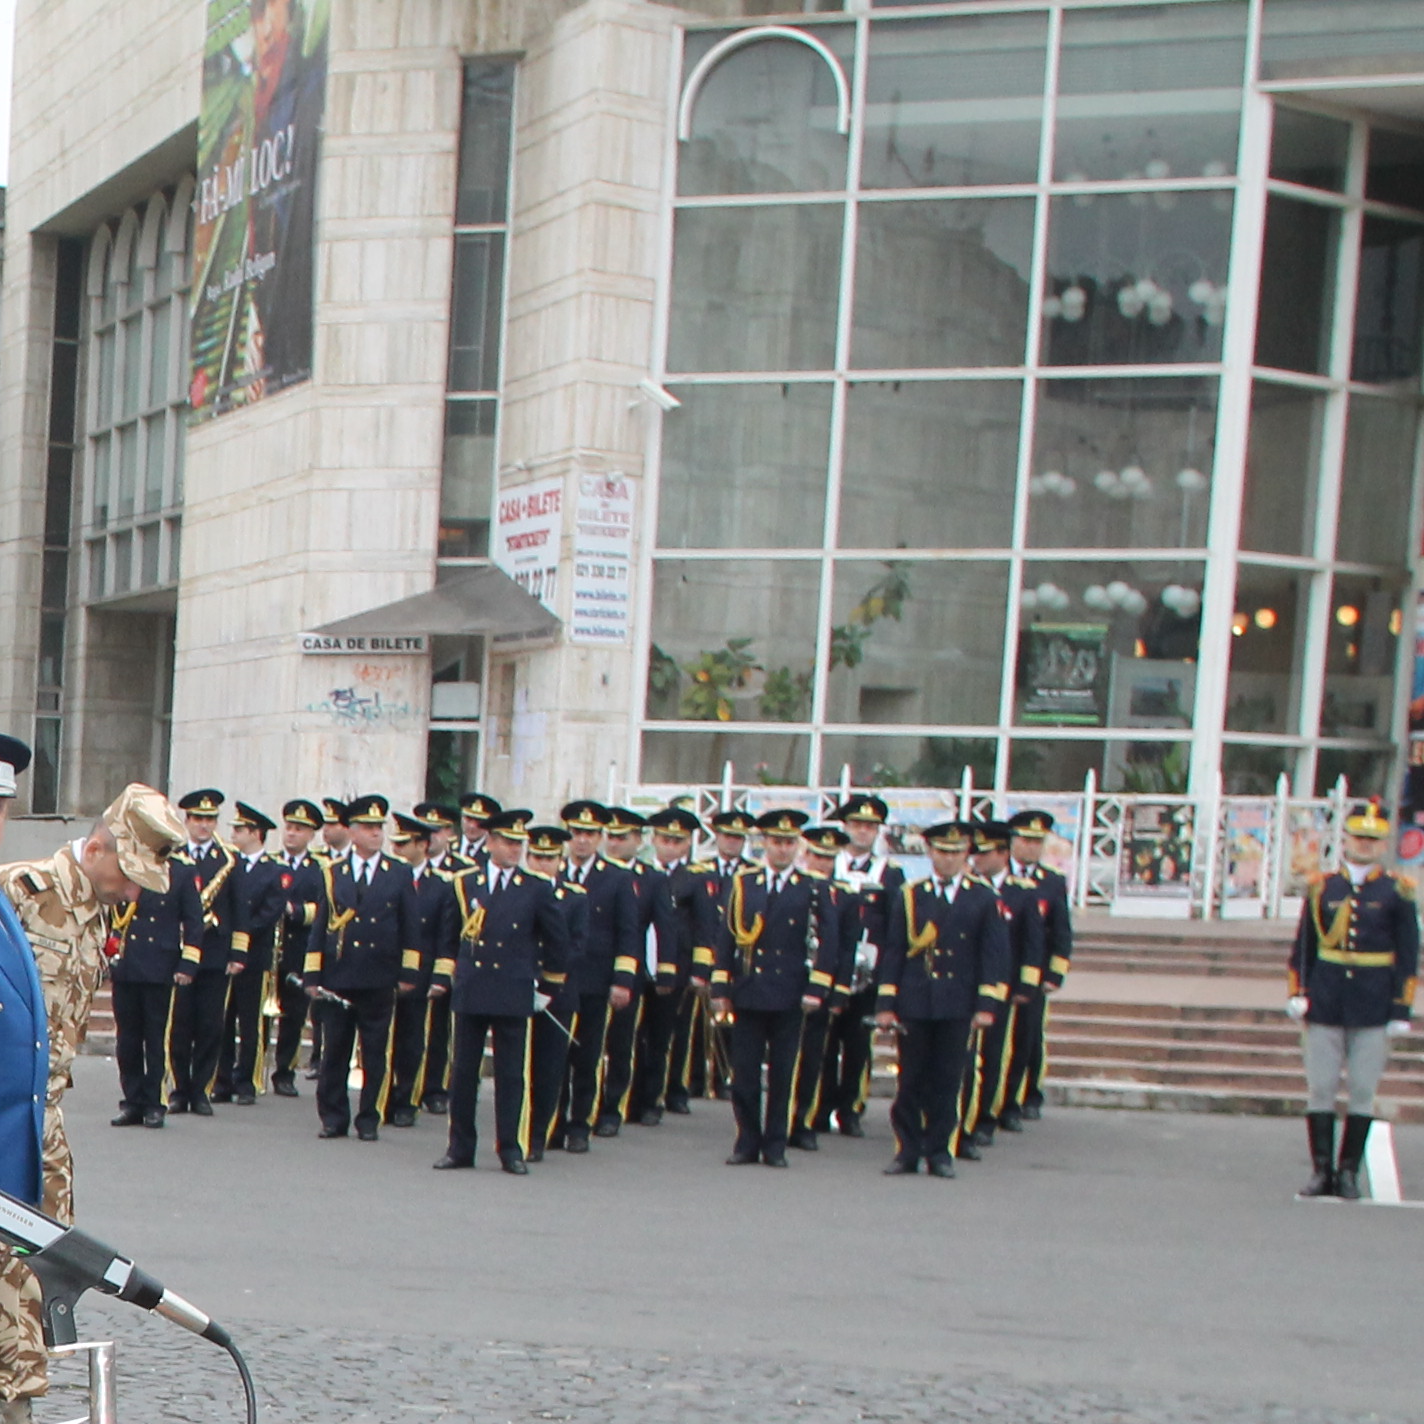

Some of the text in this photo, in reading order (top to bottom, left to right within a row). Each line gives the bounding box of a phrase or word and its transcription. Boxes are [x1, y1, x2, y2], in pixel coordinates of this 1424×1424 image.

[248, 124, 294, 196] LOC!
[578, 479, 628, 499] CASA
[499, 497, 521, 525] CASA
[527, 489, 561, 518] BILETE
[546, 566, 557, 600] 77
[617, 566, 627, 580] 77
[303, 636, 423, 650] CASA DE BILETE
